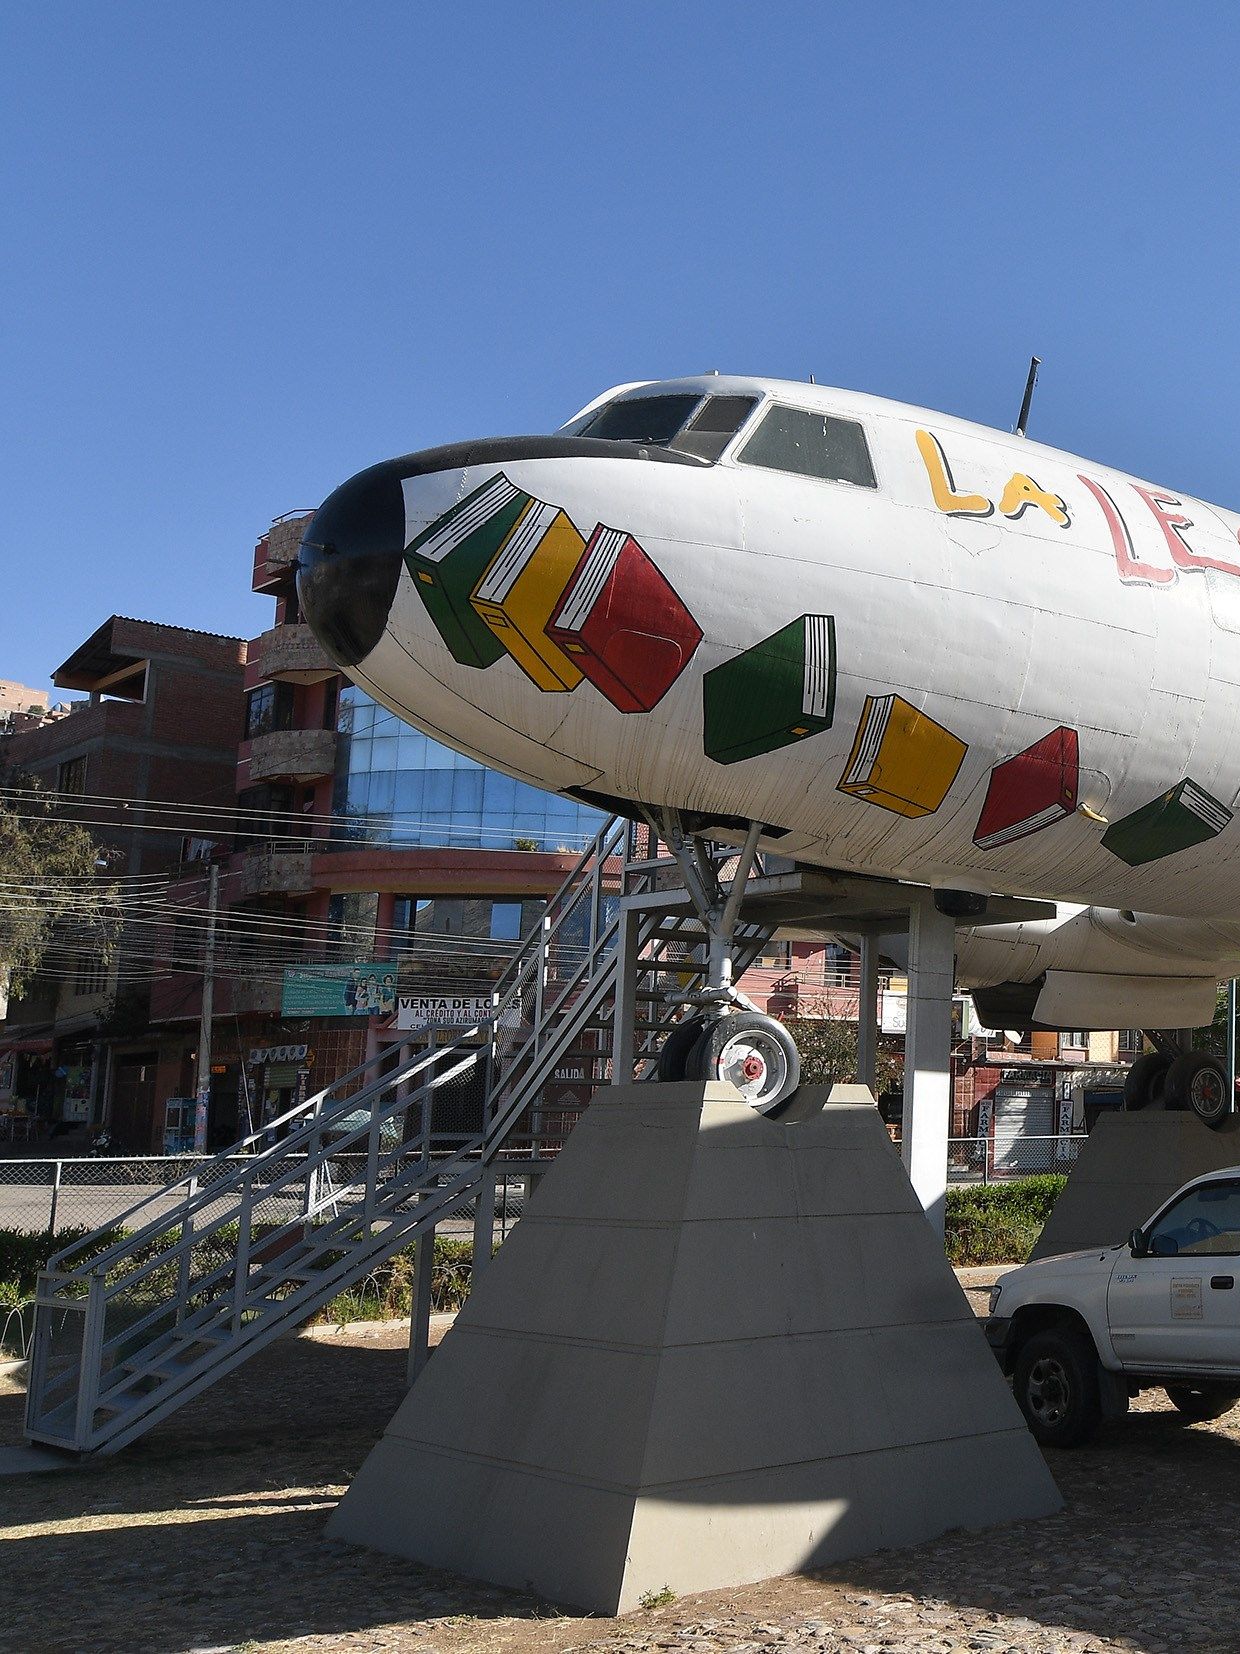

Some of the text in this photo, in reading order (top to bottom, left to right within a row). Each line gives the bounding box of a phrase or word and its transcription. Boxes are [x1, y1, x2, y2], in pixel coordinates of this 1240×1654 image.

[916, 429, 1073, 529] LA
[400, 998, 521, 1010] VENTA DE LOS
[415, 1010, 423, 1018] AL
[464, 1010, 472, 1018] AL
[554, 1067, 585, 1078] SALIDA
[1004, 1070, 1052, 1080] FARMACIA
[1060, 1107, 1070, 1158] FARMCIA
